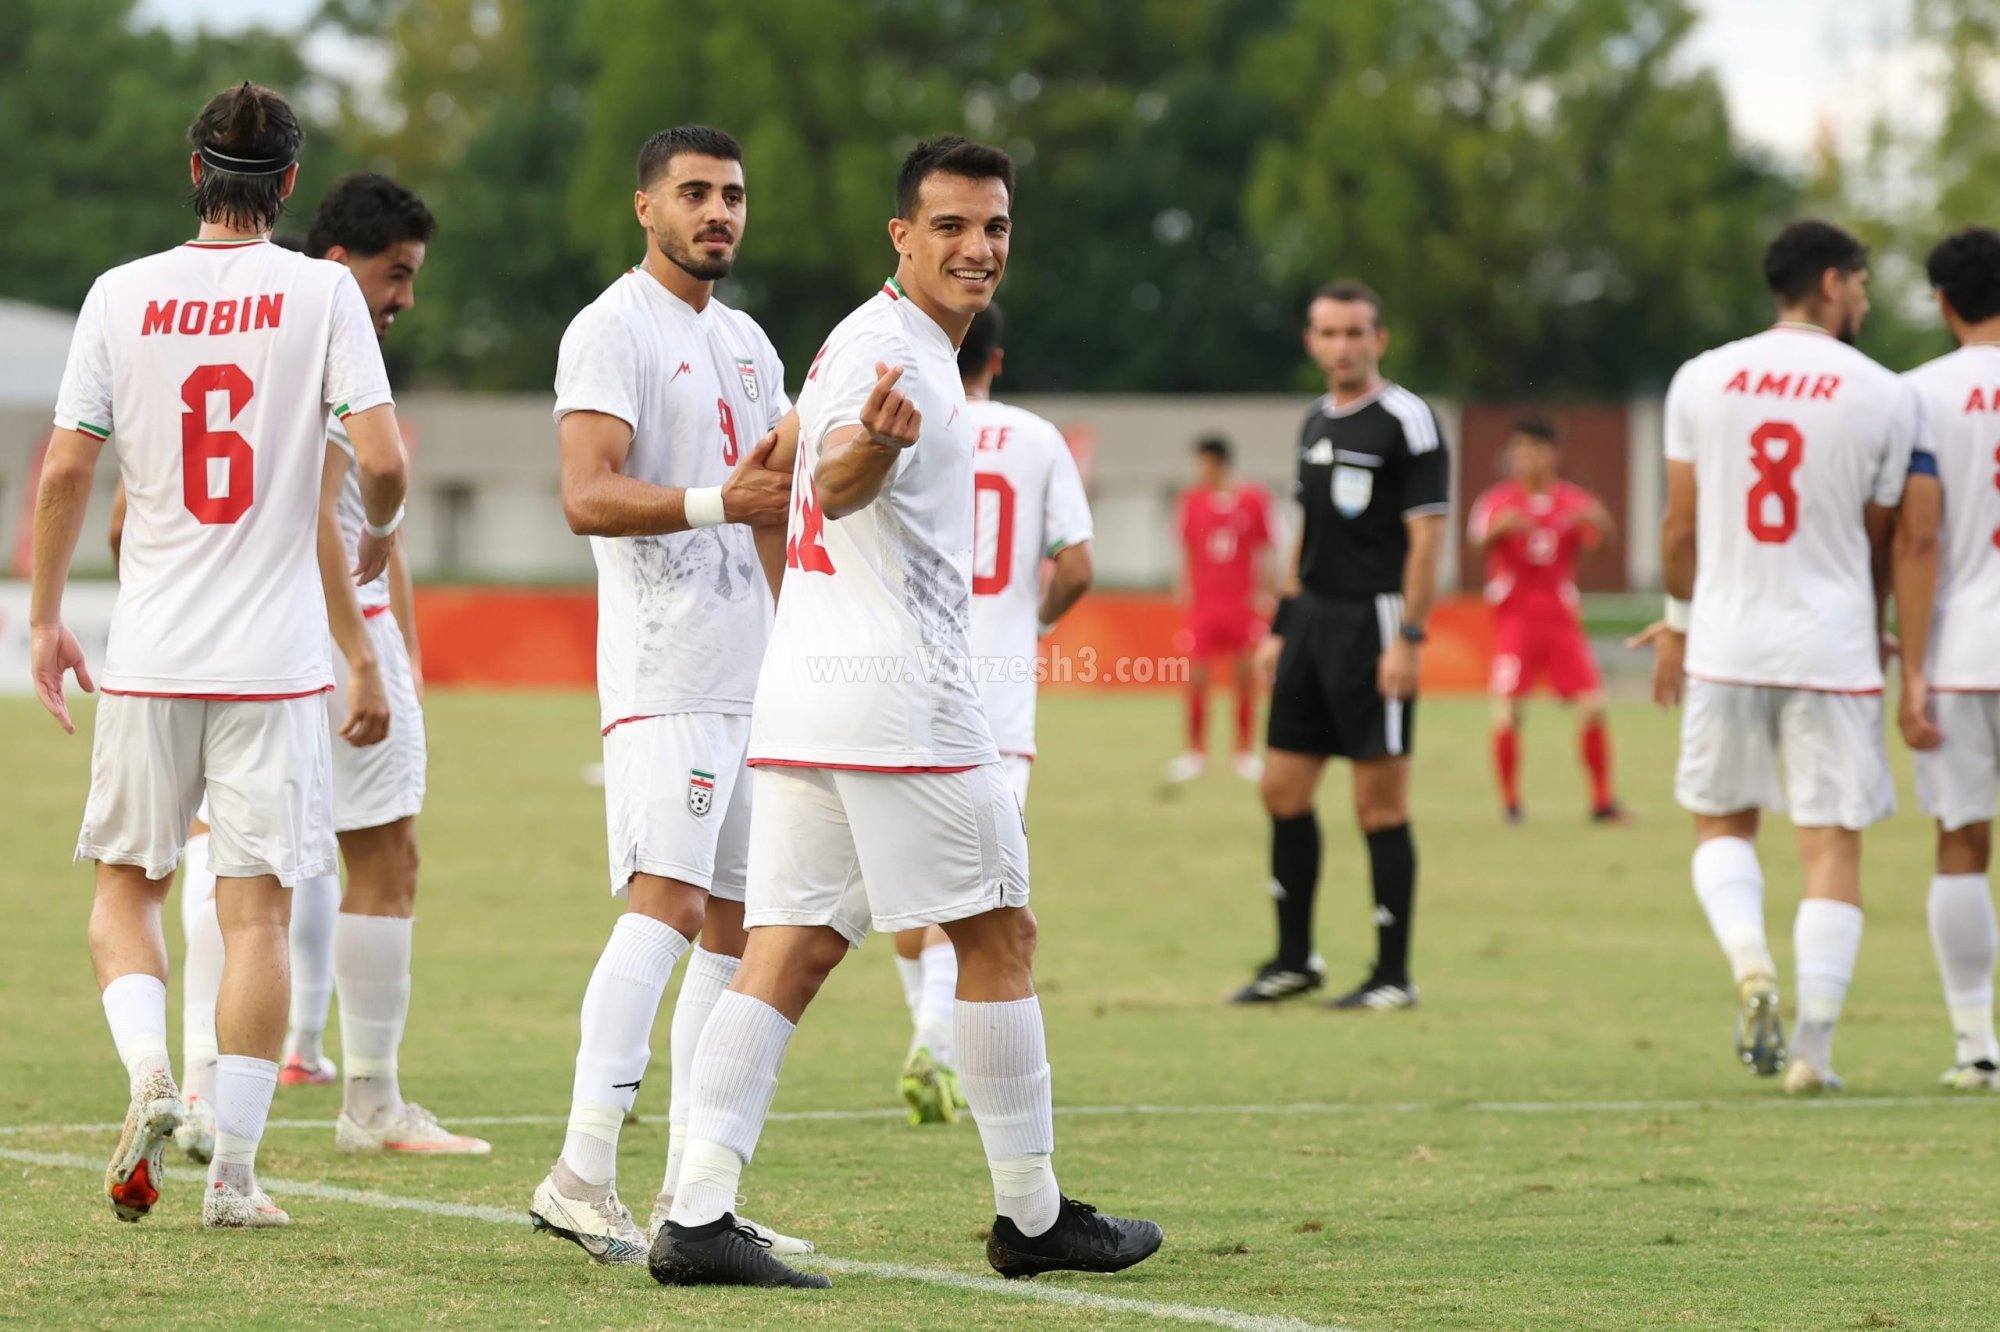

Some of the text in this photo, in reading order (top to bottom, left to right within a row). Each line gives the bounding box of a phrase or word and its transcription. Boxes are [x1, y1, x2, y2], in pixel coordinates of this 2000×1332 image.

[141, 293, 284, 336] MOBIN
[1724, 368, 1842, 401] AMIR
[181, 363, 254, 525] 6
[717, 397, 739, 467] 9
[975, 425, 1014, 450] EF
[1747, 420, 1804, 543] 8
